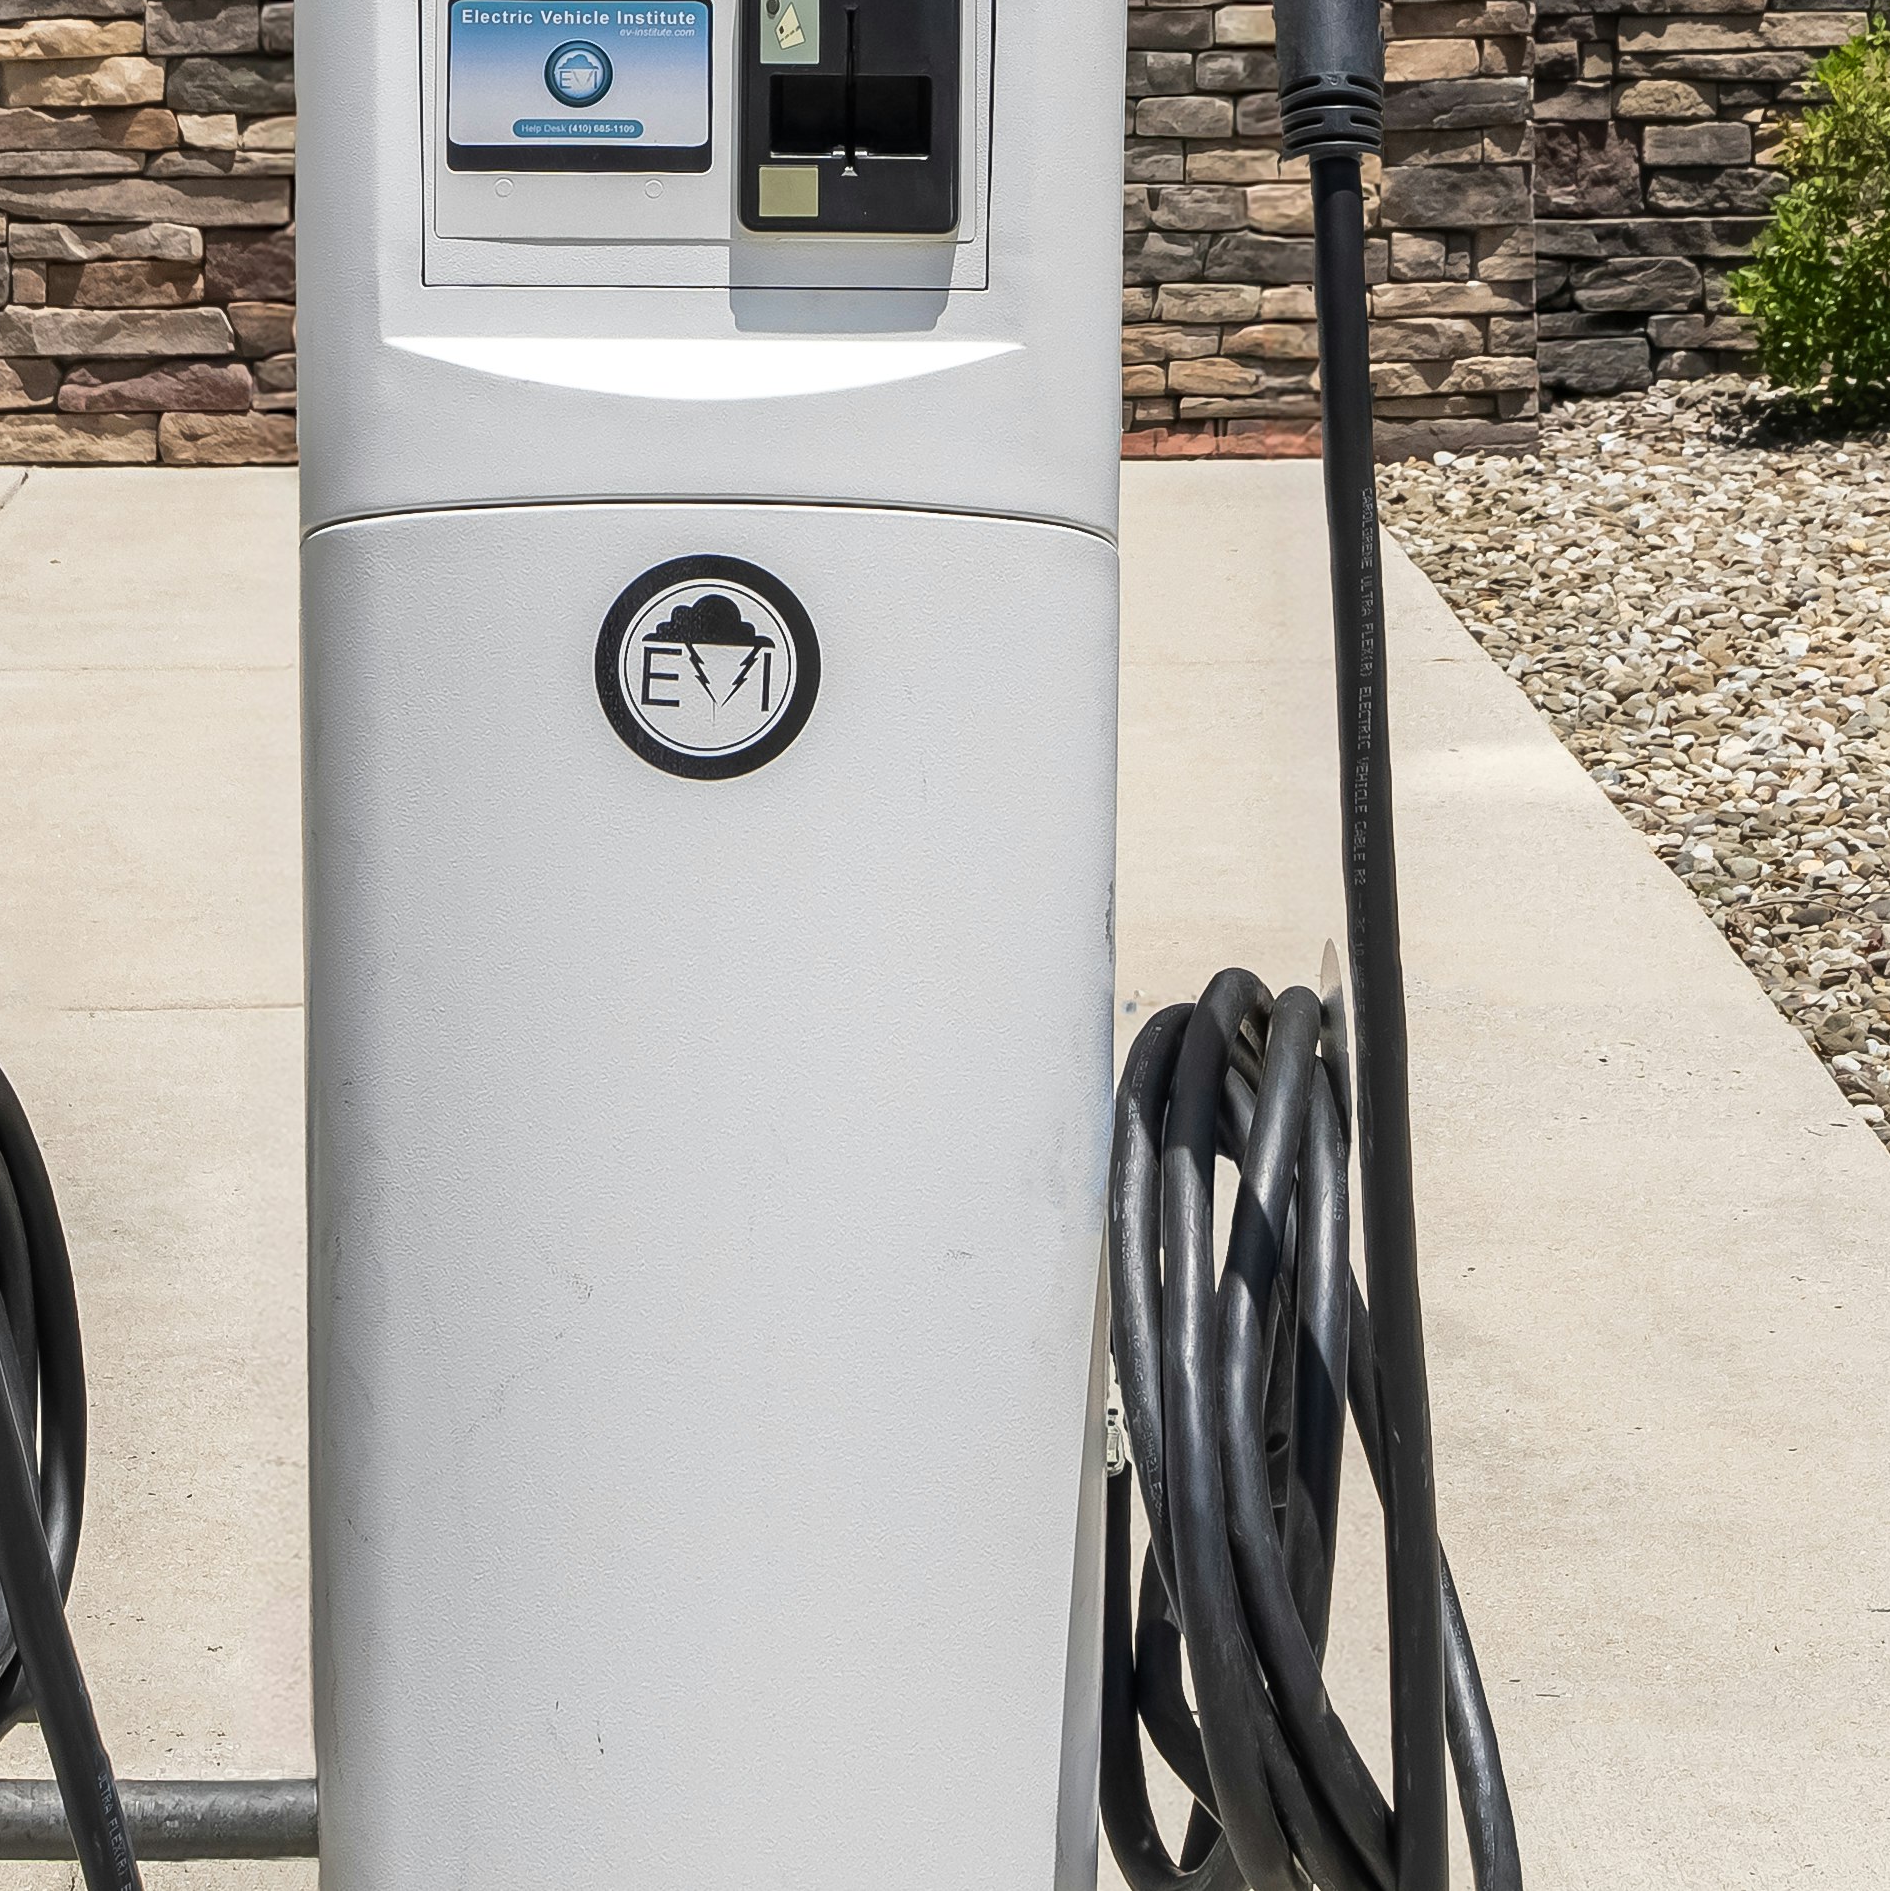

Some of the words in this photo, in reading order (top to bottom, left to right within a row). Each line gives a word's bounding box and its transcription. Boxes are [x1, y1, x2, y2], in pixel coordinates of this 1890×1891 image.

[461, 9, 533, 25] Electric
[540, 9, 610, 25] Vehicle
[616, 9, 696, 25] Institute
[619, 27, 695, 37] ev-institute.com
[521, 123, 542, 133] Help
[544, 123, 567, 132] Desk
[568, 123, 592, 134] (410)
[1360, 575, 1374, 617] ULTRA
[1357, 686, 1372, 751] ELECTRIC
[1354, 757, 1370, 814] VEHICLE
[1353, 820, 1367, 861] CABLE
